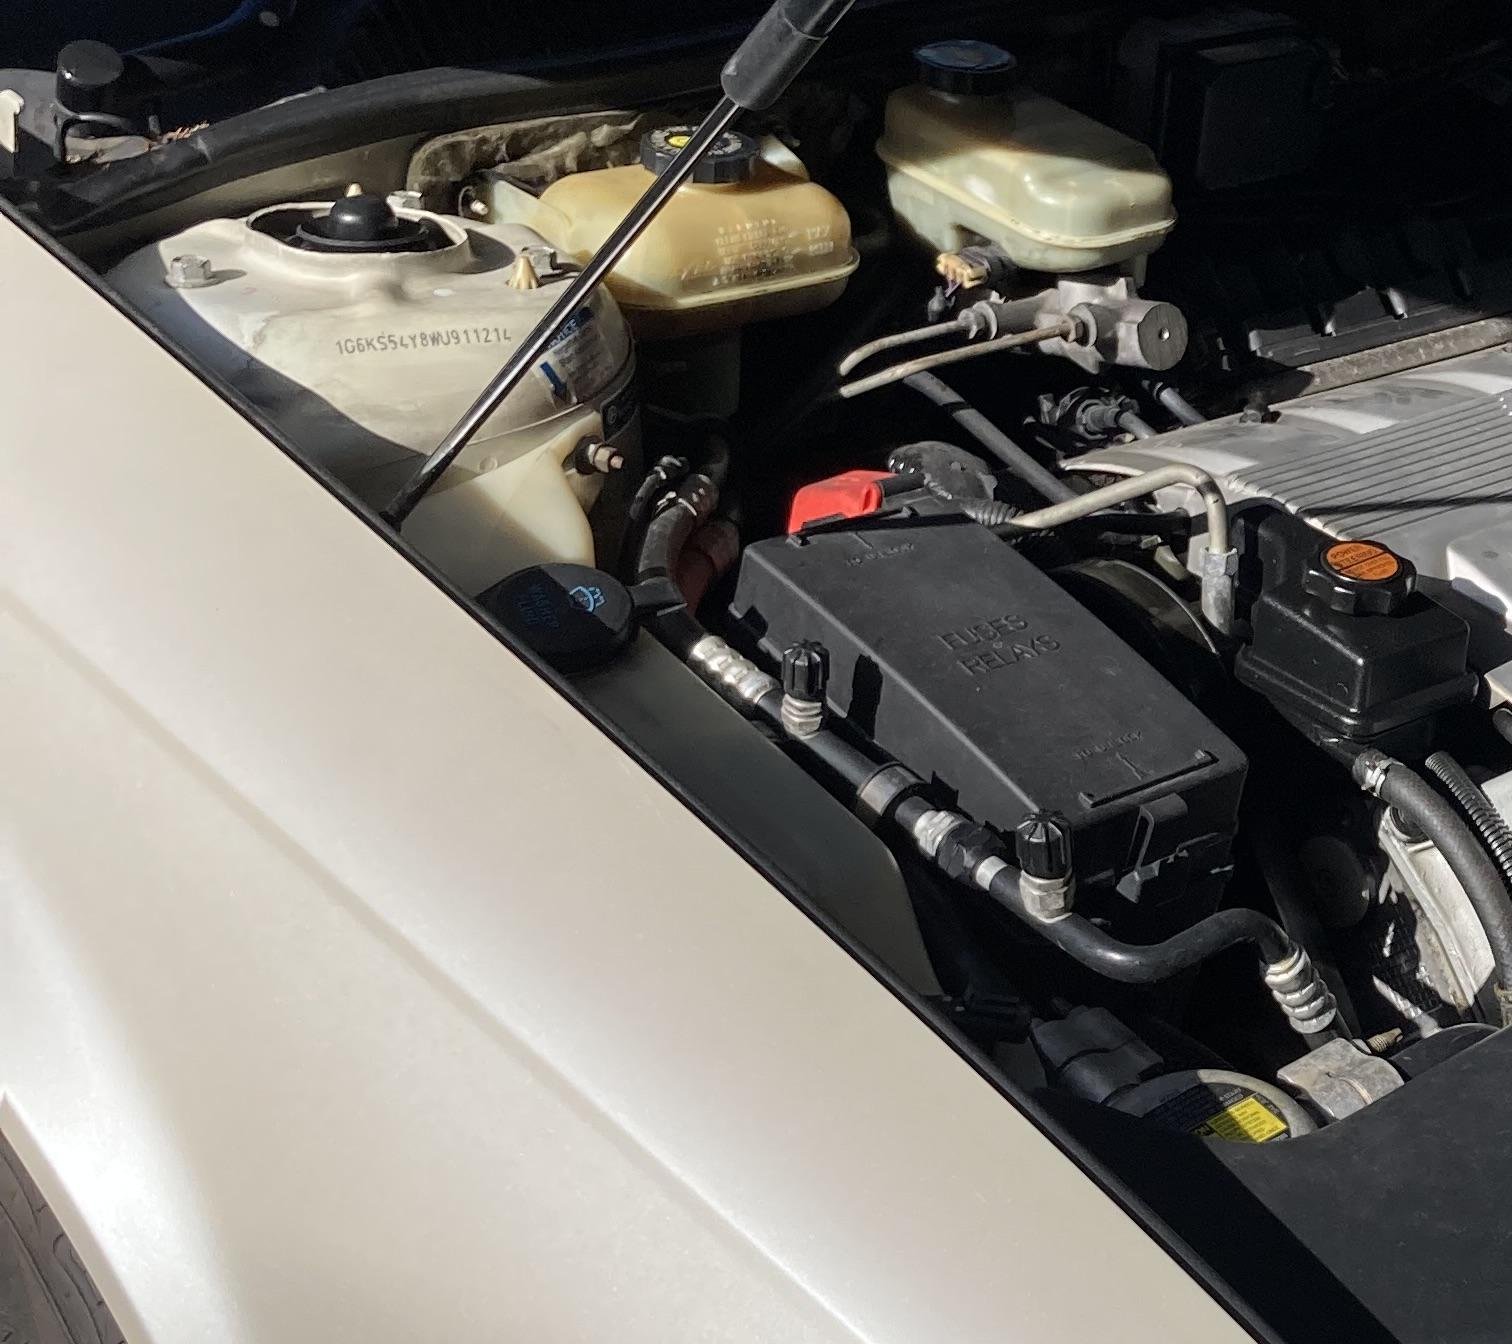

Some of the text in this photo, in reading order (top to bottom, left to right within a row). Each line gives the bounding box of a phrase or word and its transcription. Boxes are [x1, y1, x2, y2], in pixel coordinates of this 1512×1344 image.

[336, 328, 511, 355] 1G6KS54Y8WU911214
[937, 614, 1029, 650] FUSES
[957, 634, 1061, 676] RELAYS
